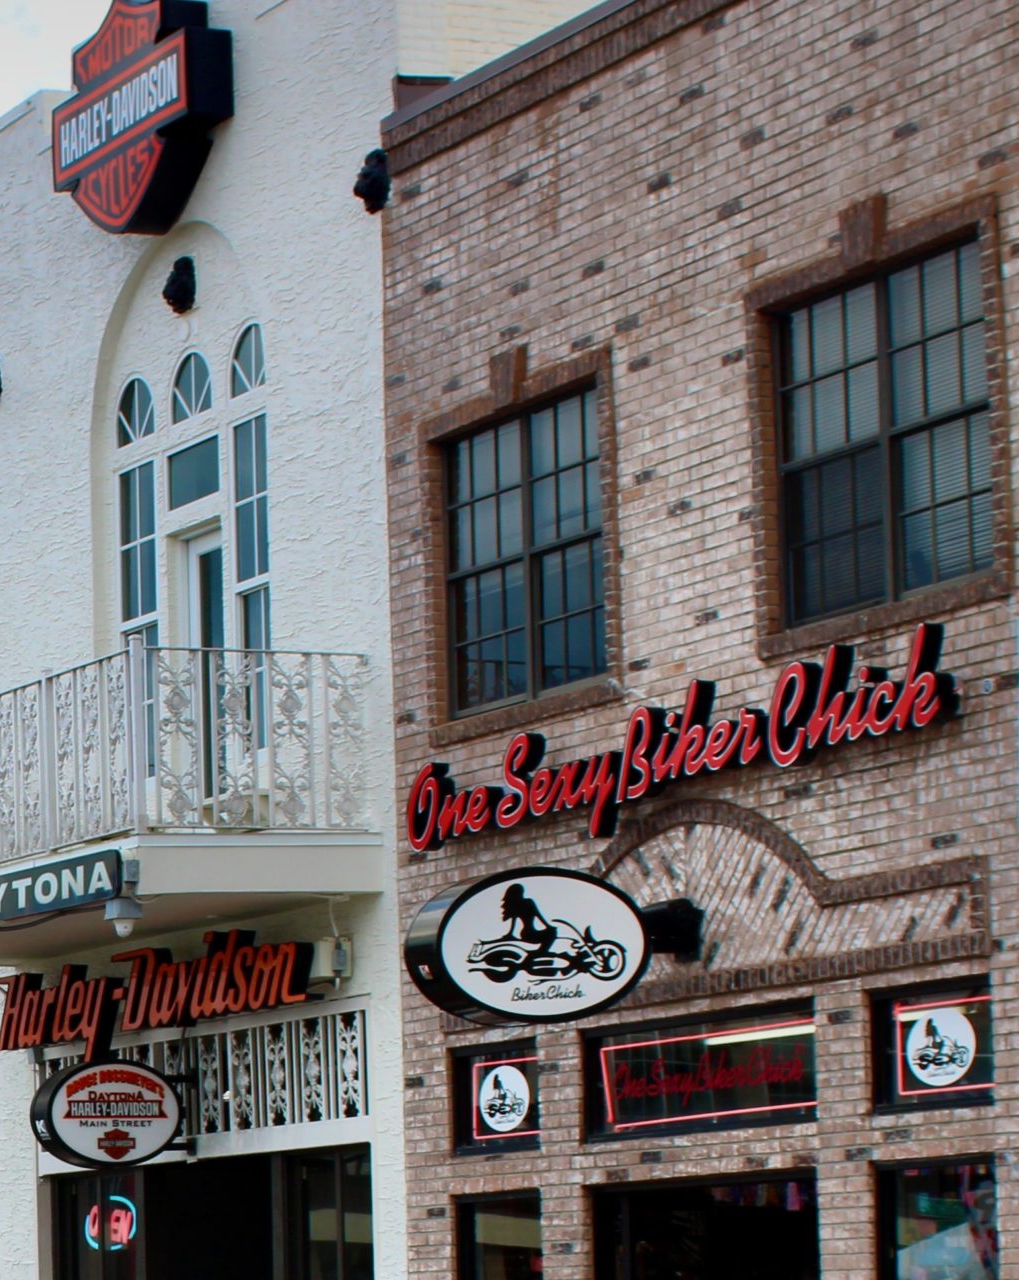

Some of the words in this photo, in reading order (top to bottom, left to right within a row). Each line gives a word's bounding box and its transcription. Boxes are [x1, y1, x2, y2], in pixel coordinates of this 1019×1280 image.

[87, 16, 151, 79] MOTOR
[60, 52, 178, 168] HARLEY-DAVIDSON
[87, 139, 151, 216] CYCLES
[406, 762, 490, 853] One
[496, 732, 616, 839] Sexy
[615, 678, 763, 804] Biker
[768, 622, 942, 768] Chick
[70, 1101, 160, 1117] HARLEY-DAVIDSON
[87, 1090, 145, 1101] DAYTONA
[79, 1119, 108, 1127] MAIN
[112, 1119, 153, 1127] STREET
[88, 1204, 133, 1245] OEN
